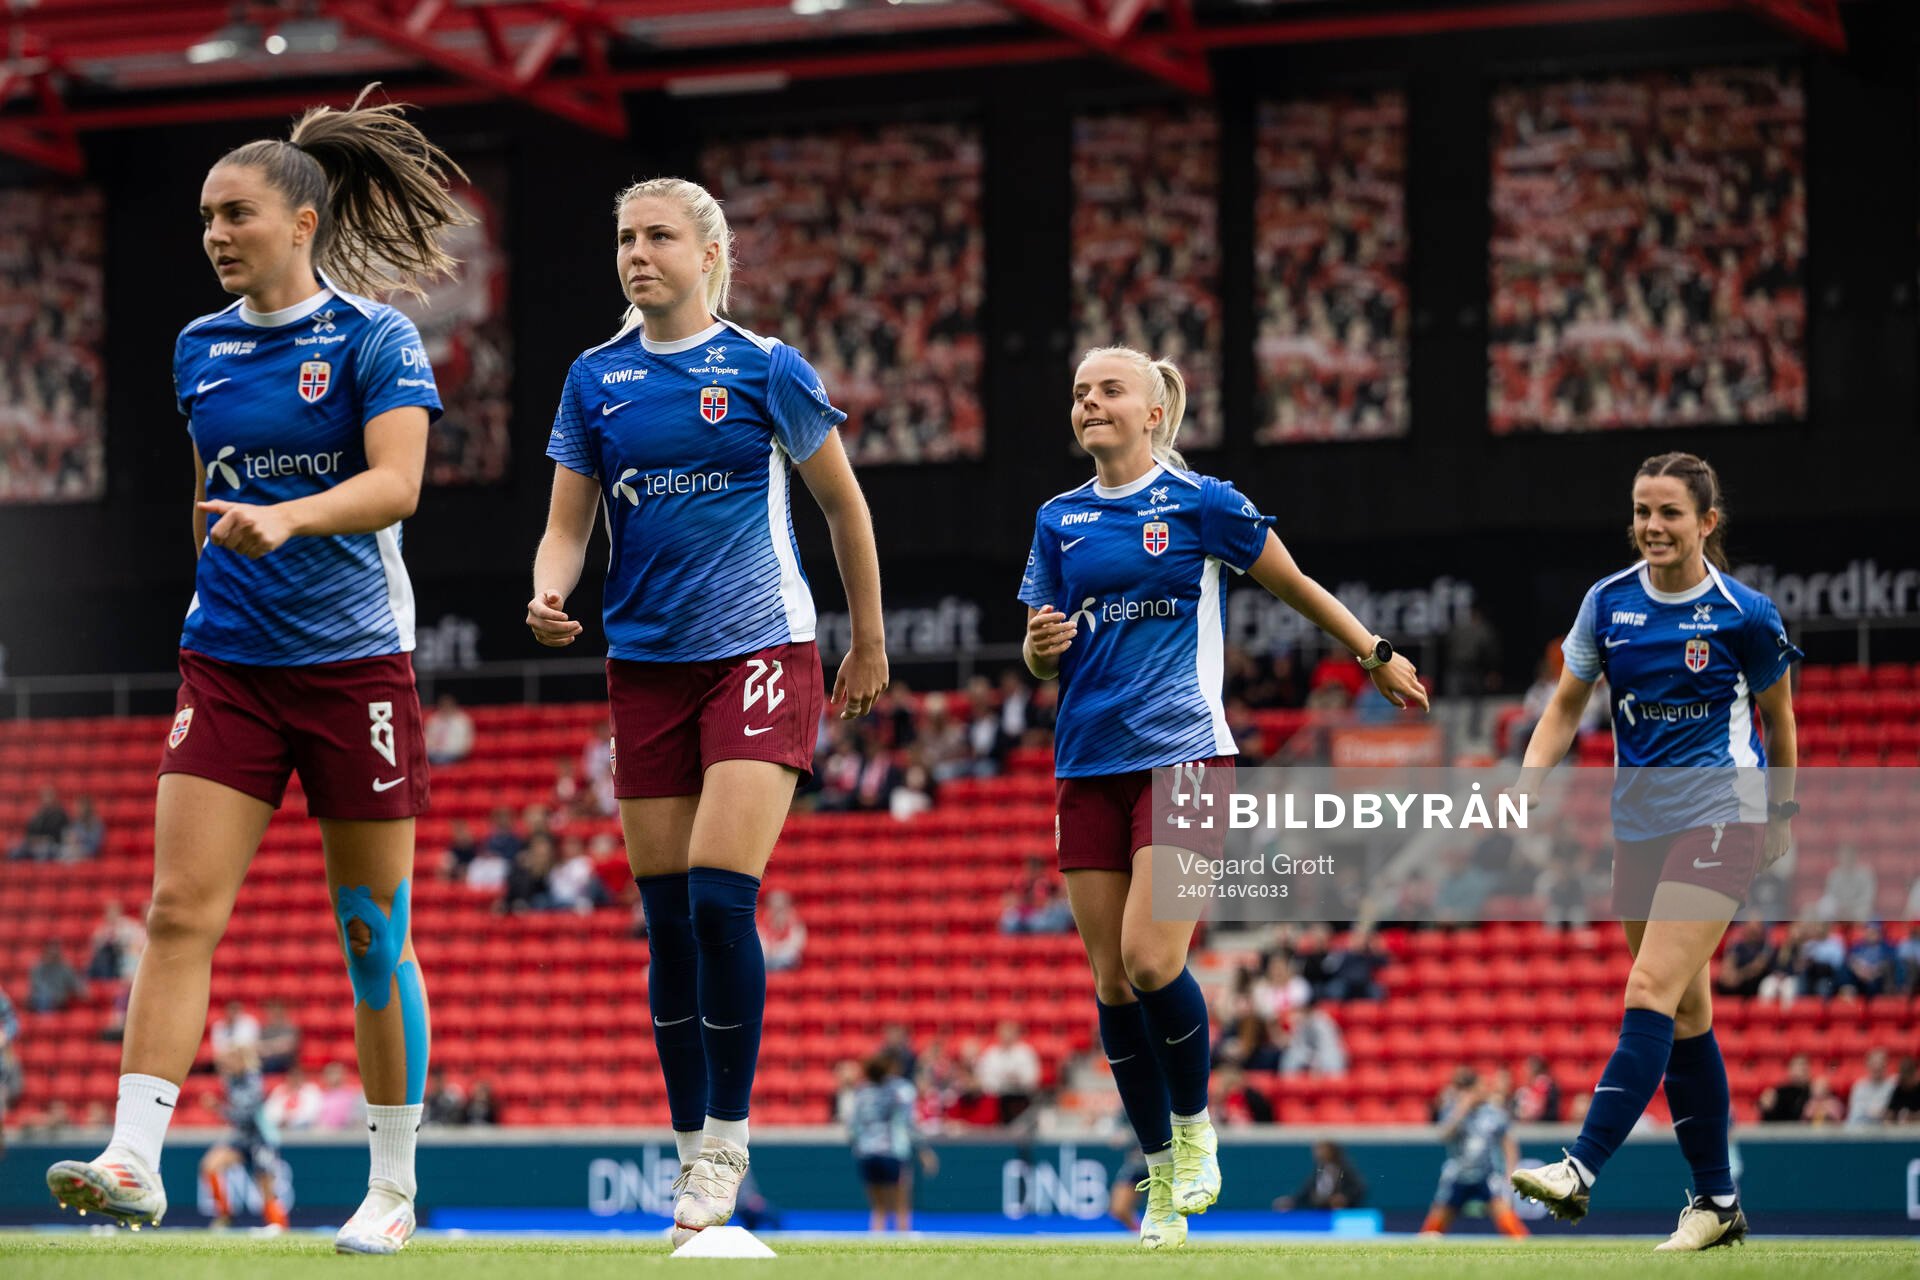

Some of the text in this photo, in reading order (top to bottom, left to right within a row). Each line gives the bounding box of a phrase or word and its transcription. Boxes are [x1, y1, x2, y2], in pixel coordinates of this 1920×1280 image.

[209, 341, 241, 358] KIWI
[602, 369, 633, 384] KIWI
[688, 366, 739, 376] Norsk Tipping
[244, 449, 343, 479] telenor
[643, 469, 735, 496] telenor
[1061, 511, 1089, 527] KIWI
[1102, 597, 1179, 623] telenor
[743, 659, 786, 714] 22
[1640, 700, 1712, 723] telenor
[368, 701, 397, 768] 8
[1002, 1142, 1108, 1220] DNB
